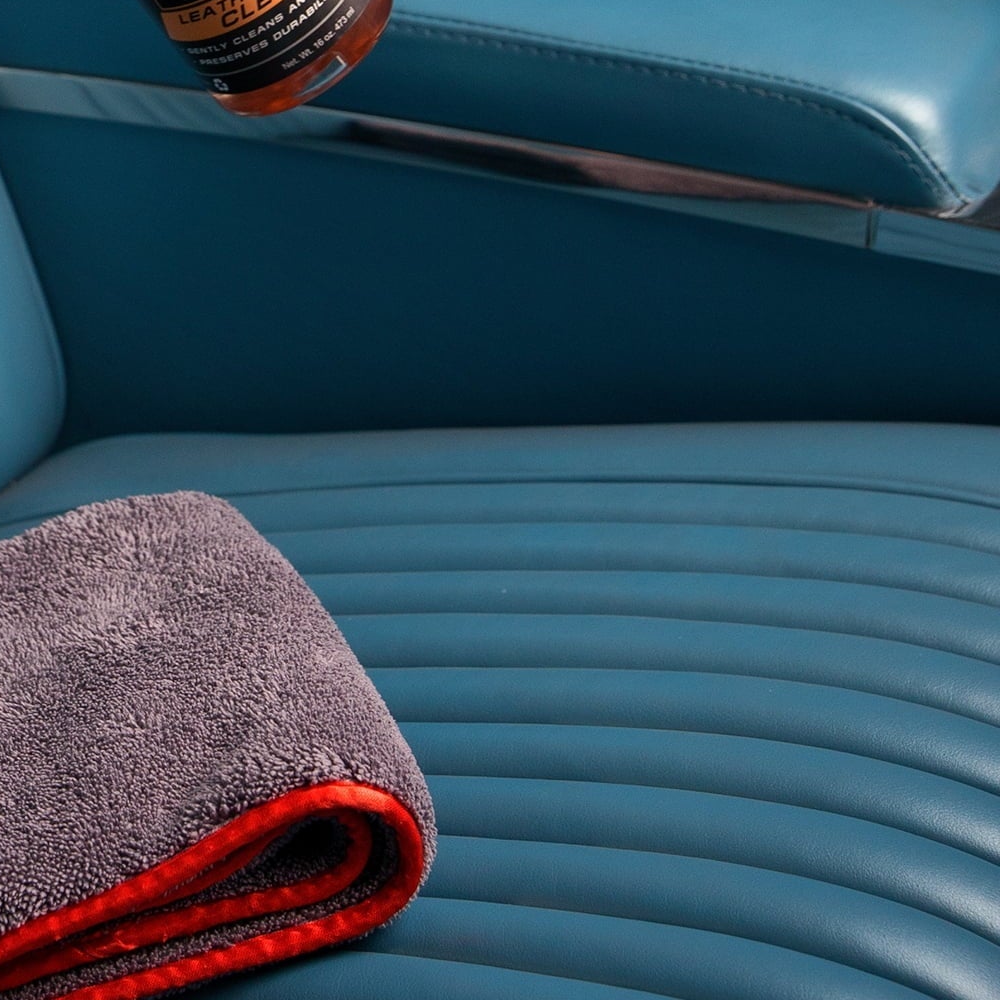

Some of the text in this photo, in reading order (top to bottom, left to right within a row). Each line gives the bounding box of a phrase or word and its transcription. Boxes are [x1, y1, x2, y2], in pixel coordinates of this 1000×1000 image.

[186, 42, 228, 55] GENTLY
[232, 12, 284, 46] CLEANS
[313, 38, 325, 49] 16
[334, 15, 348, 31] 473
[199, 39, 269, 65] PRESERVES
